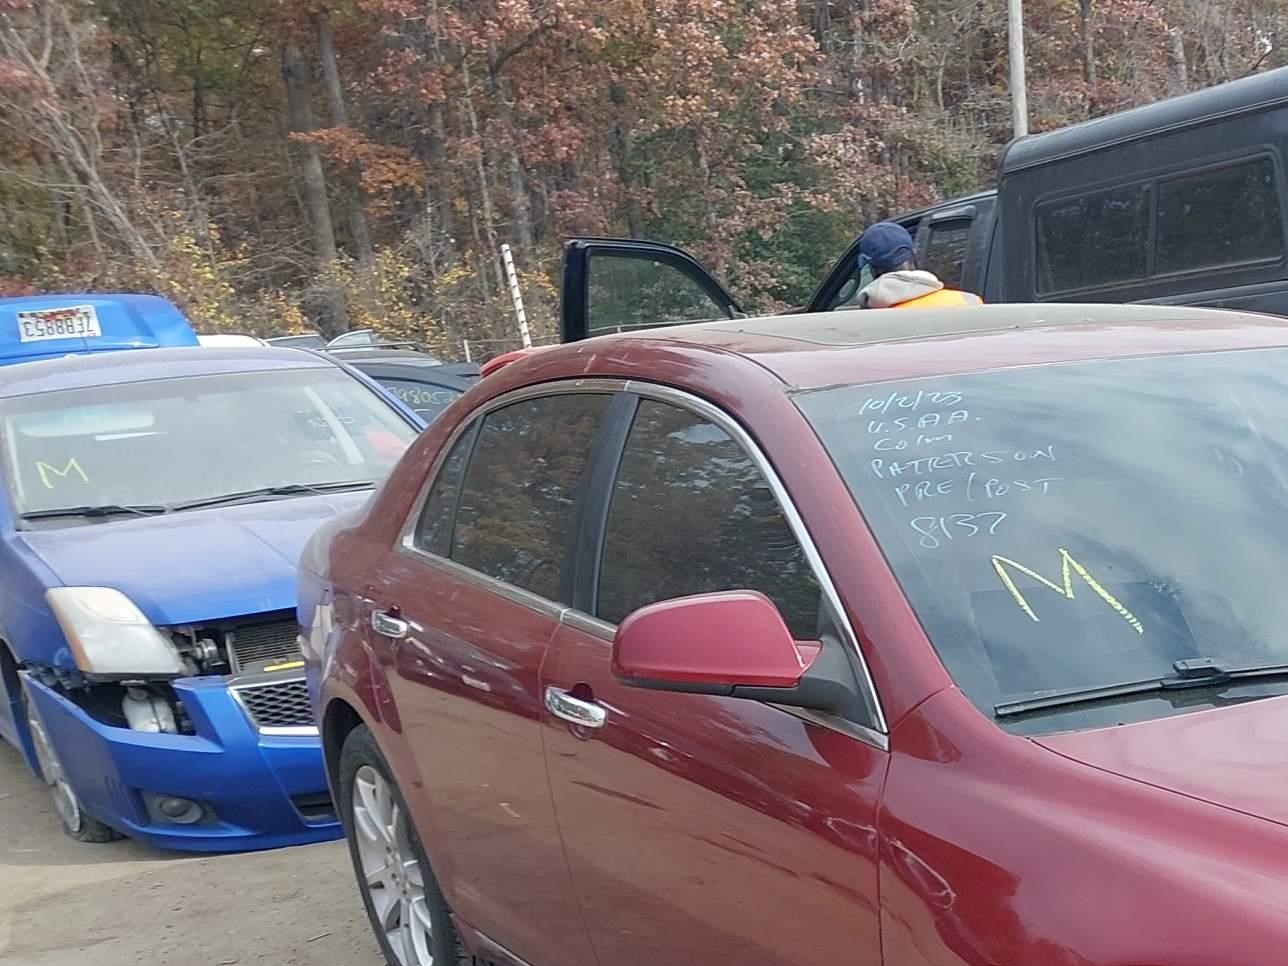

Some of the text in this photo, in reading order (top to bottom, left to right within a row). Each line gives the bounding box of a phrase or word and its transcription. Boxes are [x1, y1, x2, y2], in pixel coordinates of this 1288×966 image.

[35, 458, 89, 489] M
[910, 512, 1008, 551] 8137
[991, 547, 1145, 635] M
